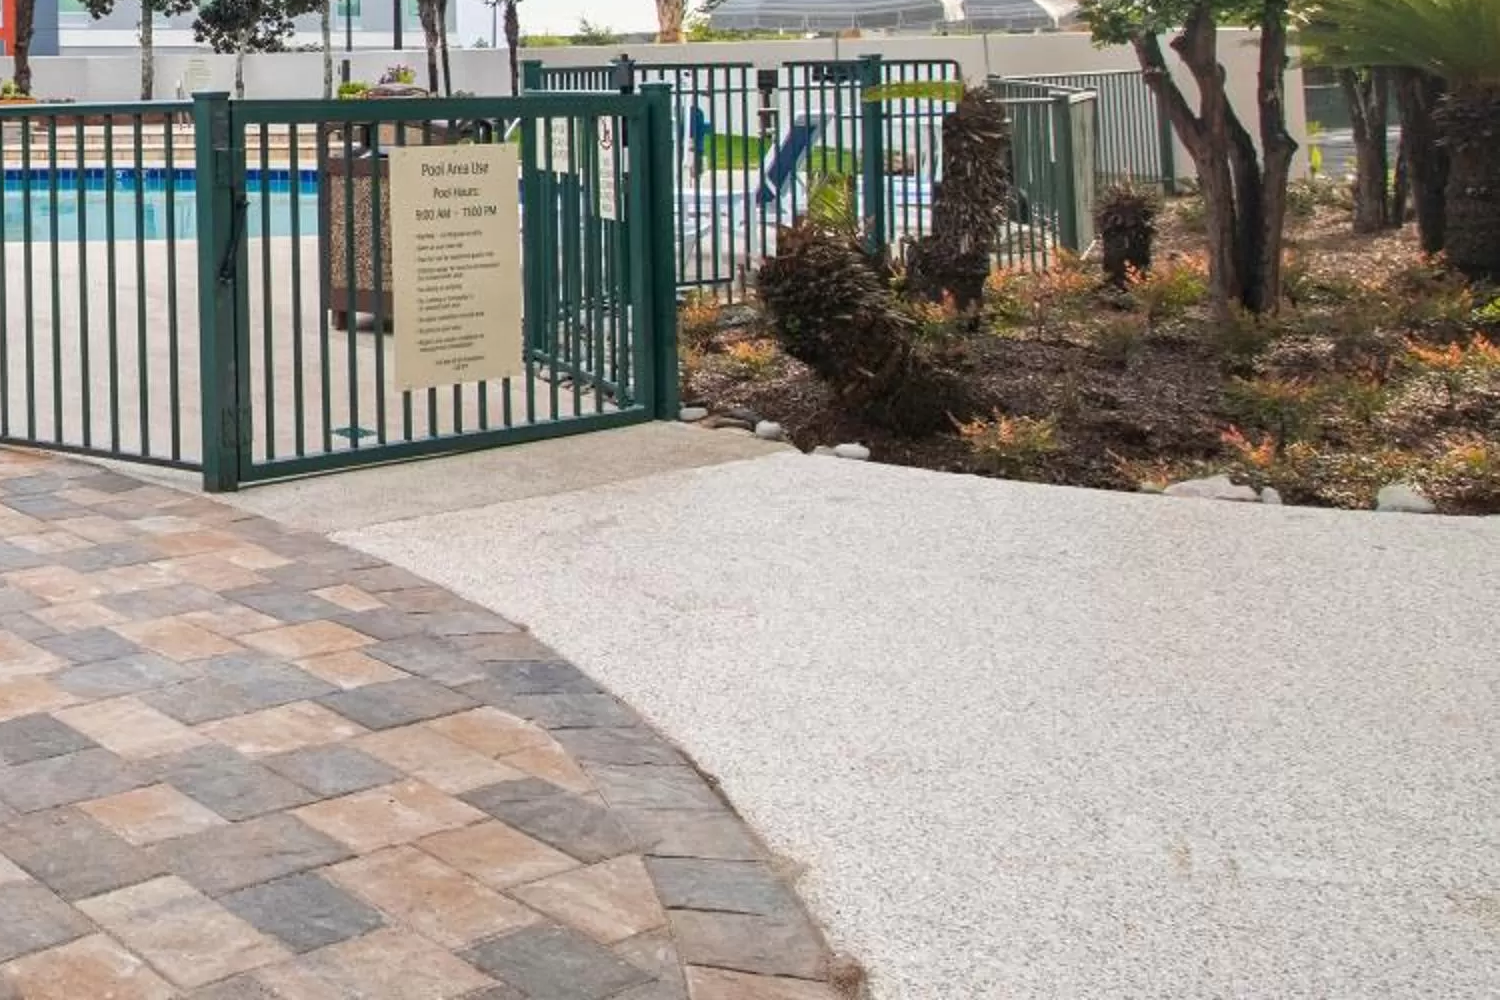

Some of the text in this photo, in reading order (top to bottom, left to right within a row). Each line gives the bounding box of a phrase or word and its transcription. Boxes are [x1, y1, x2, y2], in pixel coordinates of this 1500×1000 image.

[421, 162, 444, 176] Pool
[447, 162, 469, 175] Area
[484, 205, 497, 216] PM
